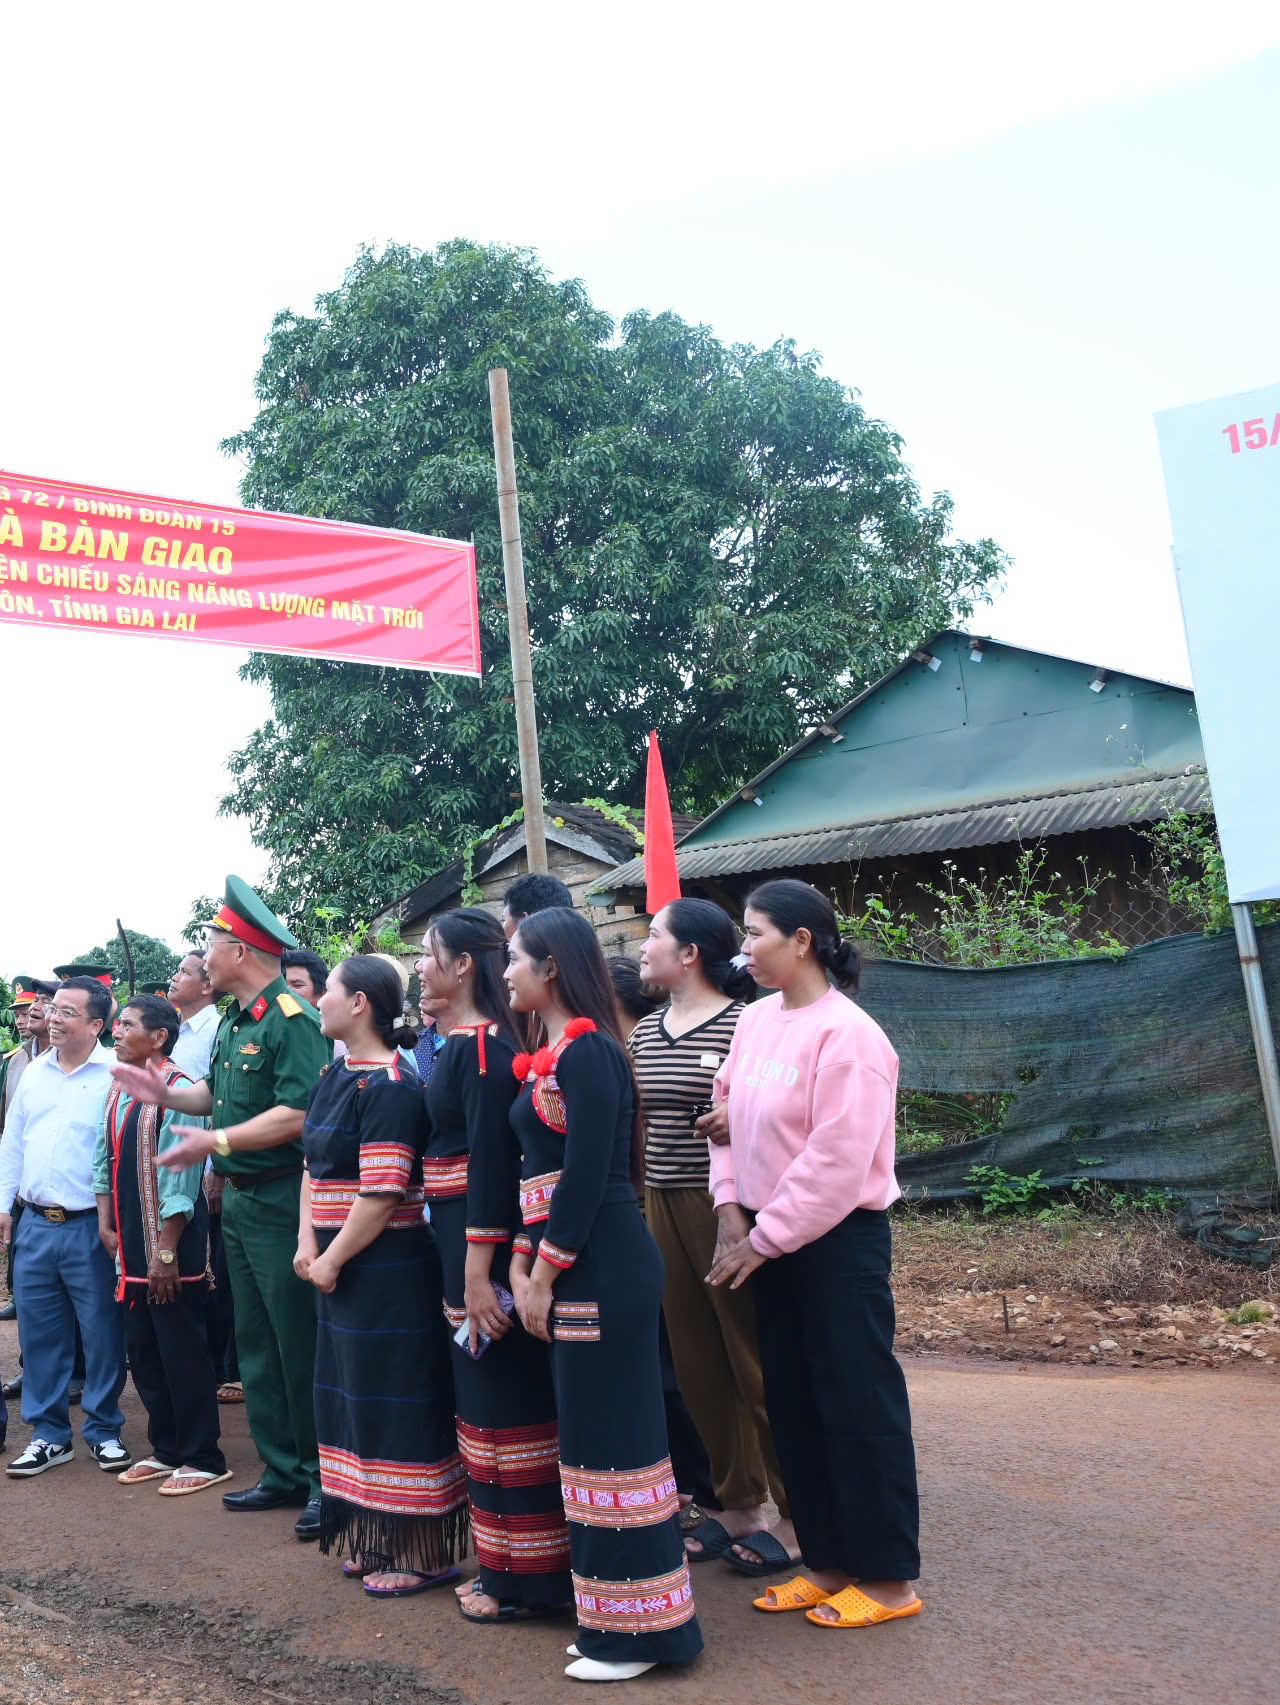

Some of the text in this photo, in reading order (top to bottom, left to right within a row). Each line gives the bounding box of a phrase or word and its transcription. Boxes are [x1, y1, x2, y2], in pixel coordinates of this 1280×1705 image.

[19, 488, 50, 508] 72
[56, 495, 66, 511] /
[73, 496, 132, 522] BINH
[138, 504, 203, 531] ĐOÀN
[211, 519, 236, 536] 15
[39, 519, 129, 562] BÀN
[140, 536, 234, 577] GIAO
[37, 561, 110, 593] CHIẾU
[117, 570, 181, 602] SÁNG
[187, 580, 253, 610] NĂNG
[258, 591, 326, 620] LƯỢNG
[330, 598, 375, 628] MẶT
[382, 605, 424, 631] TRỜI
[49, 593, 110, 624] TỈNH
[116, 607, 155, 628] GIA
[161, 611, 197, 634] LAI
